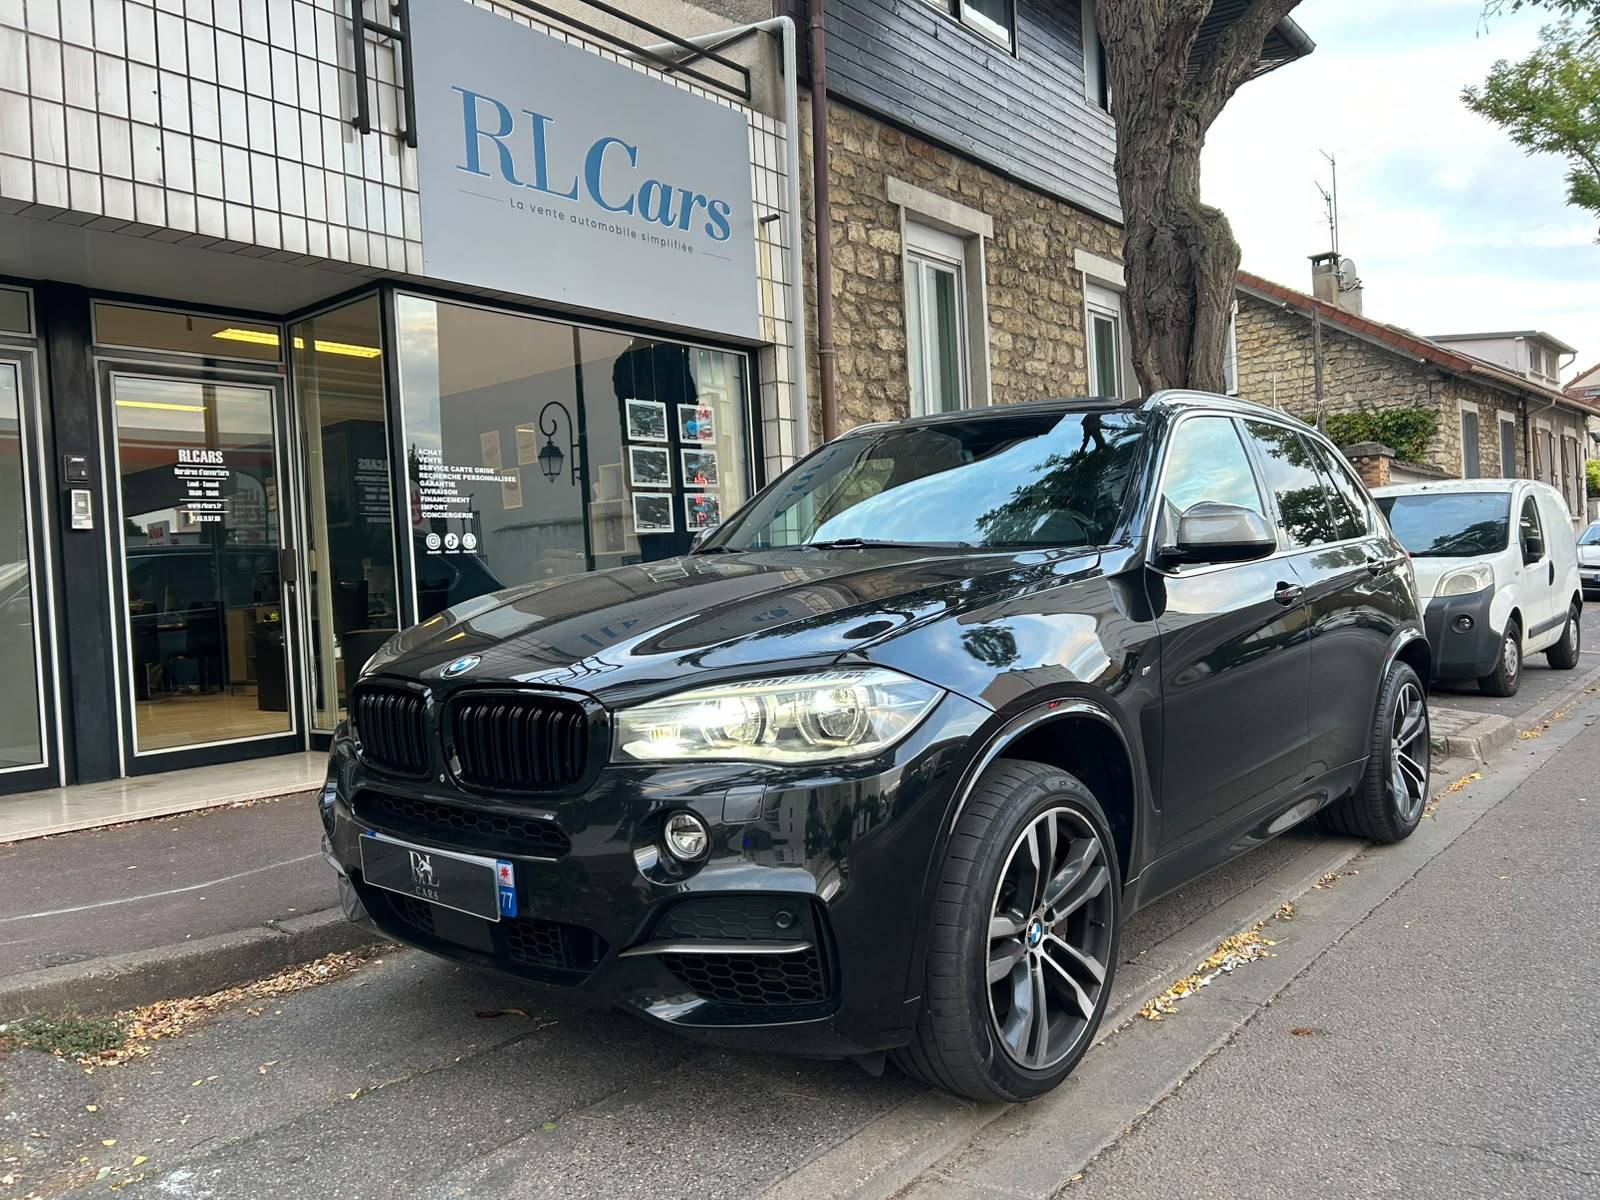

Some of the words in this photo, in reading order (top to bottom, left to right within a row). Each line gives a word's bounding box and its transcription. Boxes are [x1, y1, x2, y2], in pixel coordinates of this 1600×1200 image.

[451, 85, 732, 242] RLCars
[510, 197, 524, 210] La
[530, 207, 565, 220] vente
[570, 213, 637, 239] automobile
[641, 231, 694, 254] simplifiée
[178, 449, 223, 463] RLCARS
[415, 886, 439, 900] CARS
[500, 891, 513, 909] 77
